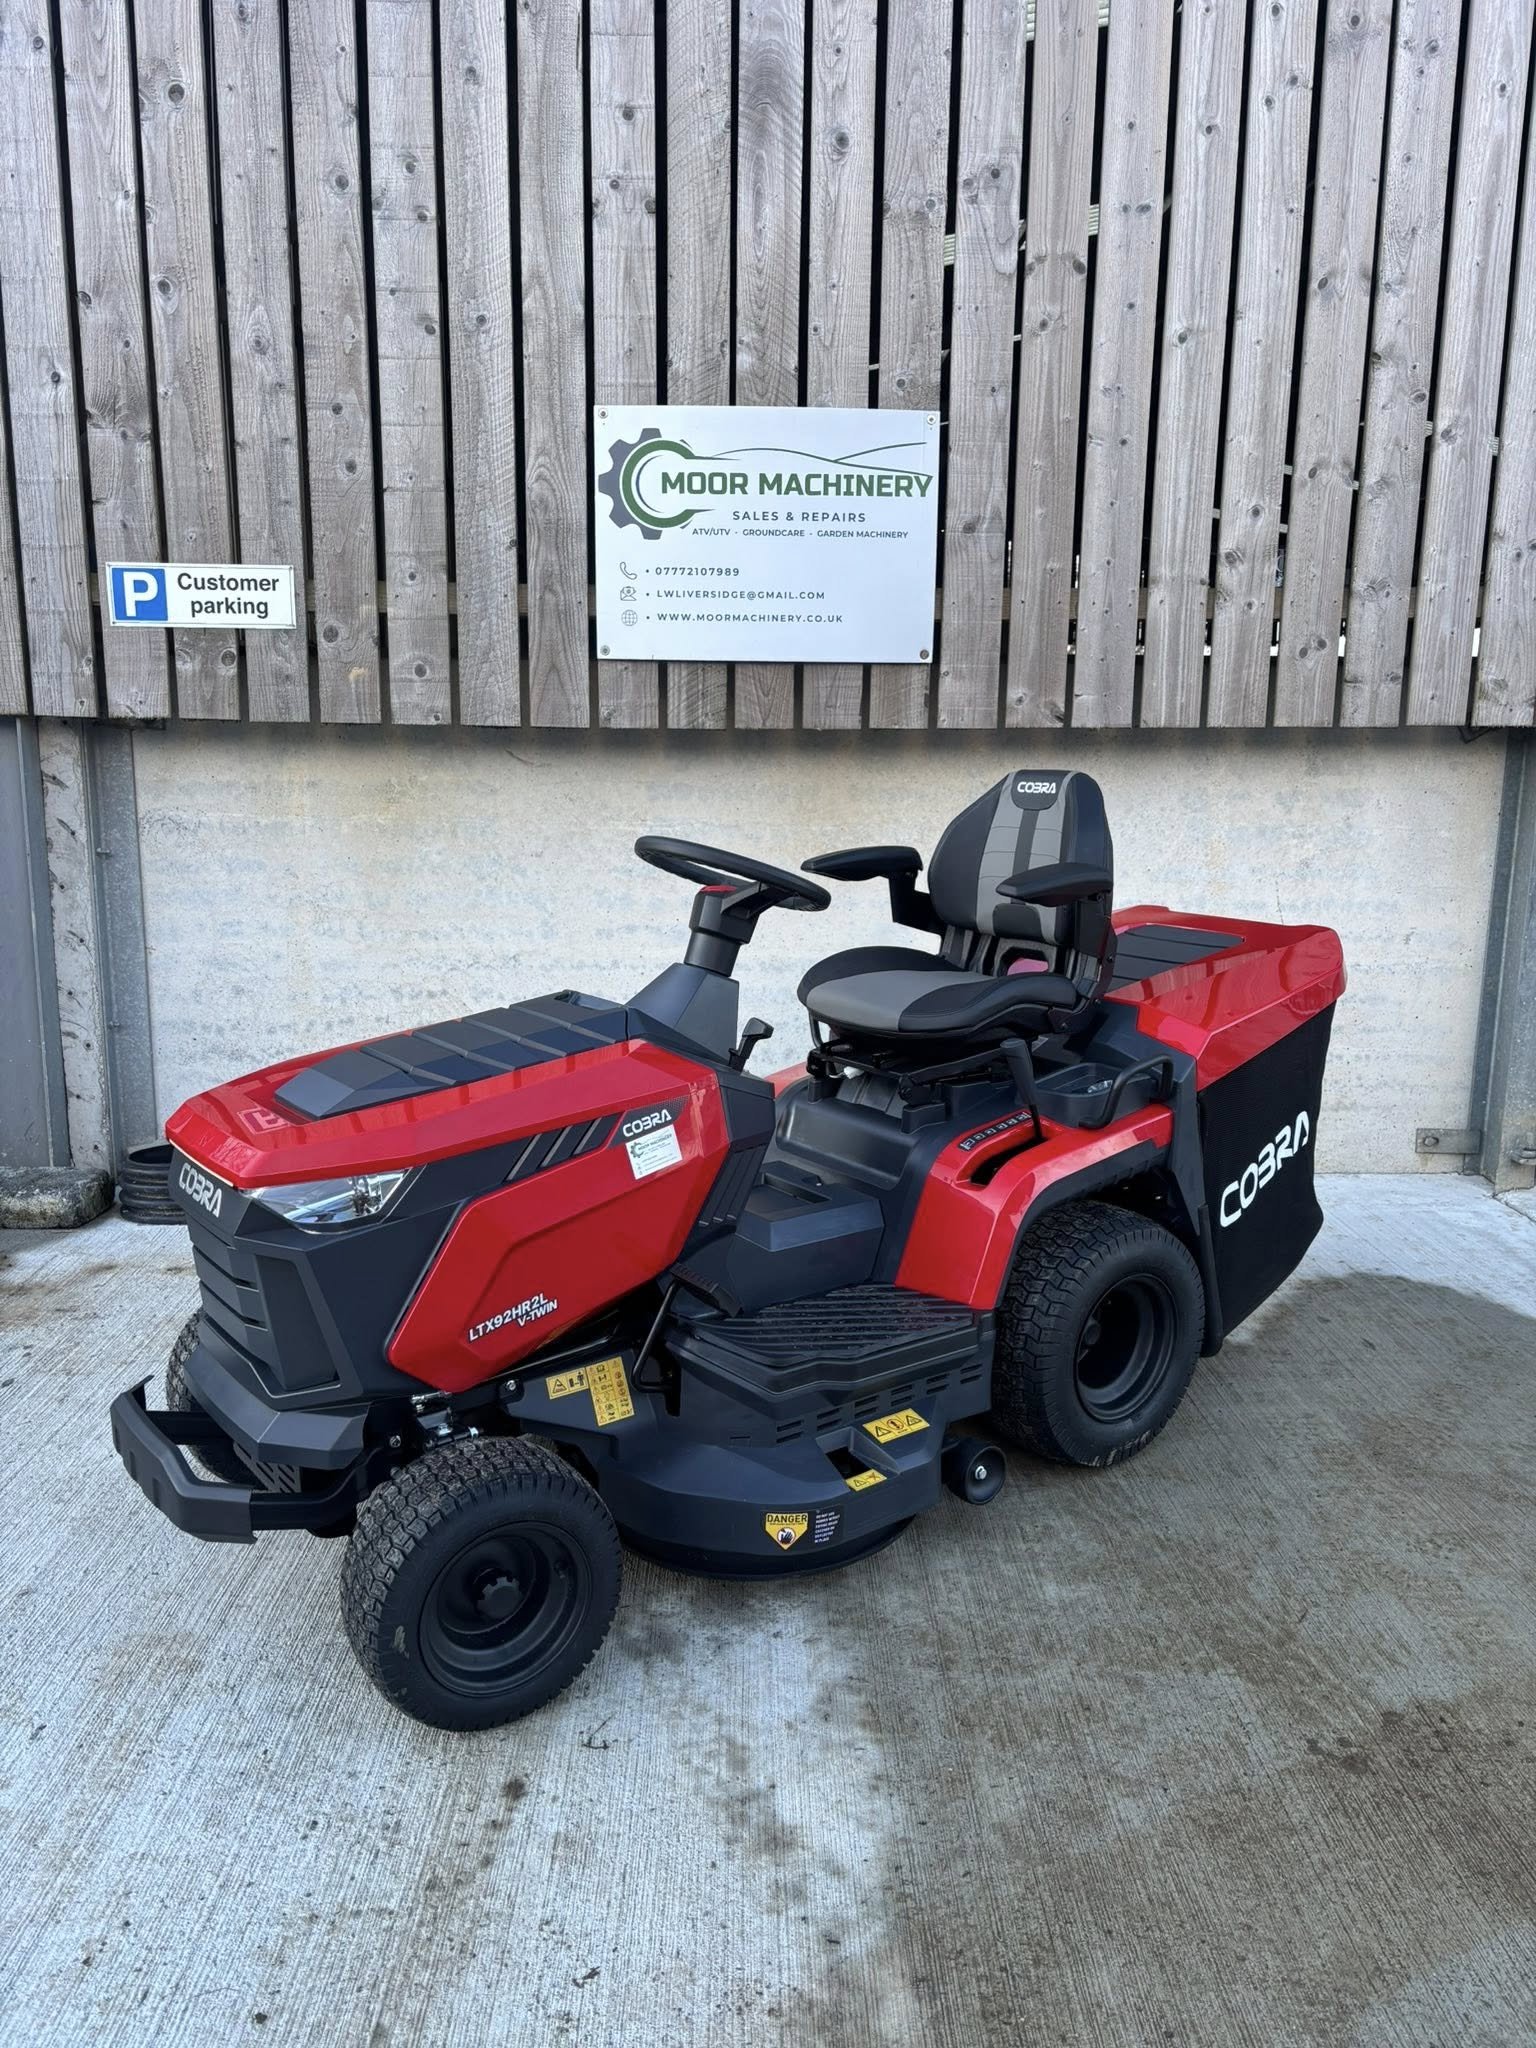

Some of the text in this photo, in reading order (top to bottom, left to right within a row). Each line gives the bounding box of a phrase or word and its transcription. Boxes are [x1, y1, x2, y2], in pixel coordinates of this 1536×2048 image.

[661, 471, 933, 498] MOOR MACHINERY
[732, 510, 867, 523] SALES & REPAIRS
[692, 528, 731, 536] ATV/UTV
[742, 528, 805, 537] GROUNDCARE
[817, 530, 854, 538] GARDEN
[856, 530, 909, 539] MACHINERY
[177, 572, 280, 592] Customer
[655, 566, 740, 577] 07772107989
[122, 571, 159, 617] P
[656, 589, 826, 601] LWLIVERSIDGE@GMAIL.COM
[190, 597, 269, 620] parking
[657, 612, 844, 624] WWW.MOORMACHINERY.CO.UK
[1017, 781, 1057, 794] COBRA
[622, 1108, 672, 1137] COBRA
[1219, 1110, 1310, 1228] COBRA
[179, 1162, 222, 1218] COBRA
[469, 1293, 548, 1341] LTX92HR2L
[517, 1299, 558, 1327] V-TWIN
[767, 1514, 808, 1523] DANGER
